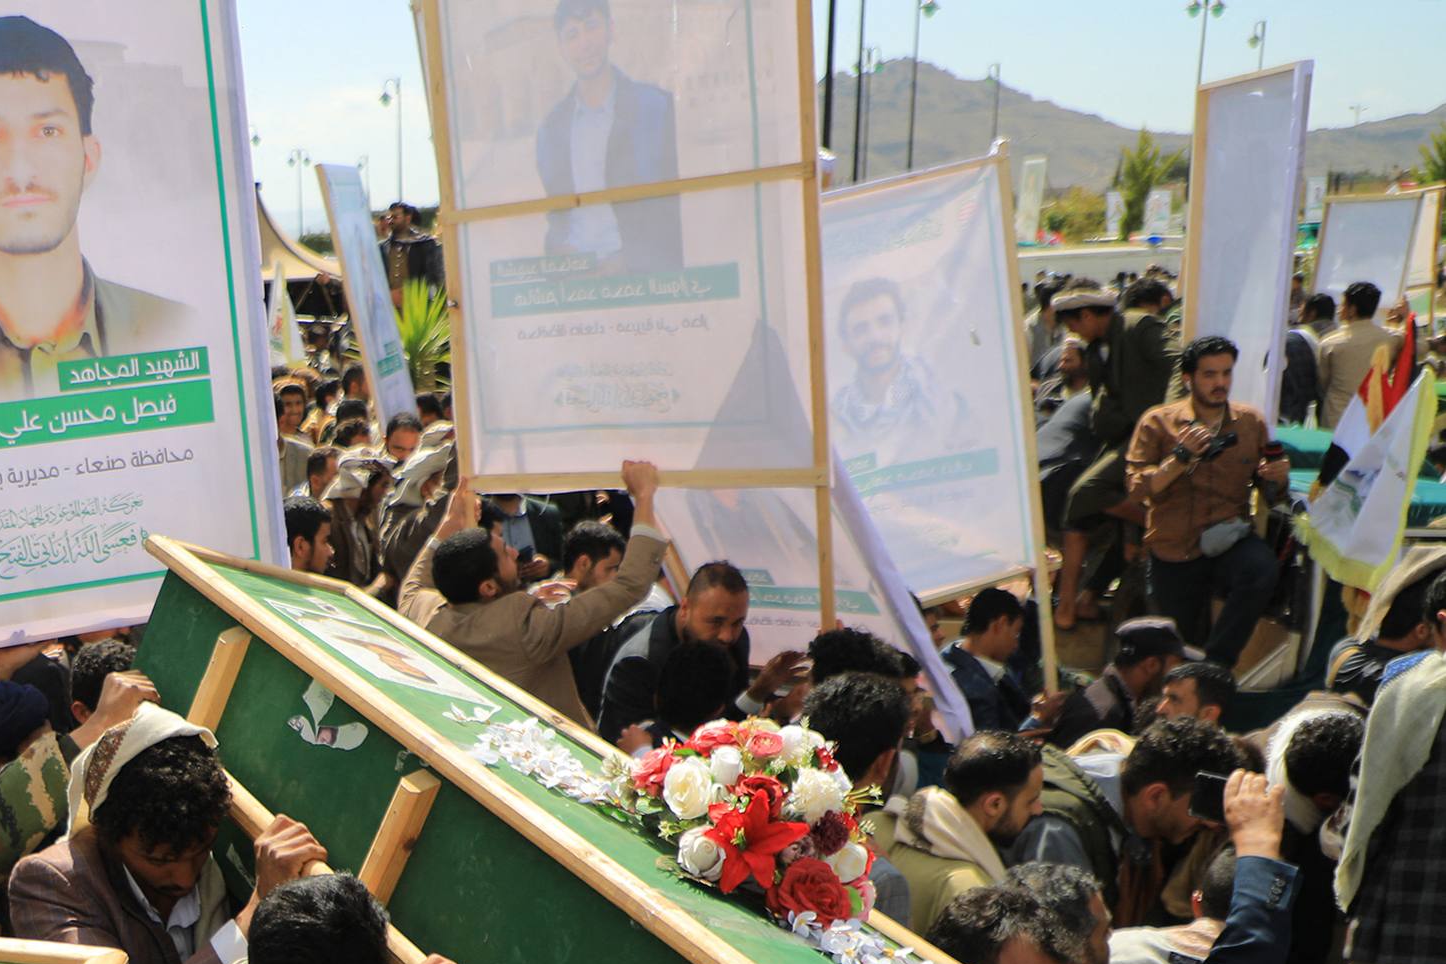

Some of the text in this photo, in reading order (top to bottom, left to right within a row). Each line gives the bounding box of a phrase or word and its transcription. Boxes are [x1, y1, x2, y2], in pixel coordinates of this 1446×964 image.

[69, 351, 200, 386] الشهيد المجاهد
[48, 406, 116, 434] محسن
[121, 393, 177, 425] فيصل
[75, 456, 126, 476] صنعاء
[131, 447, 194, 469] محافظة
[7, 465, 59, 488] مديرية
